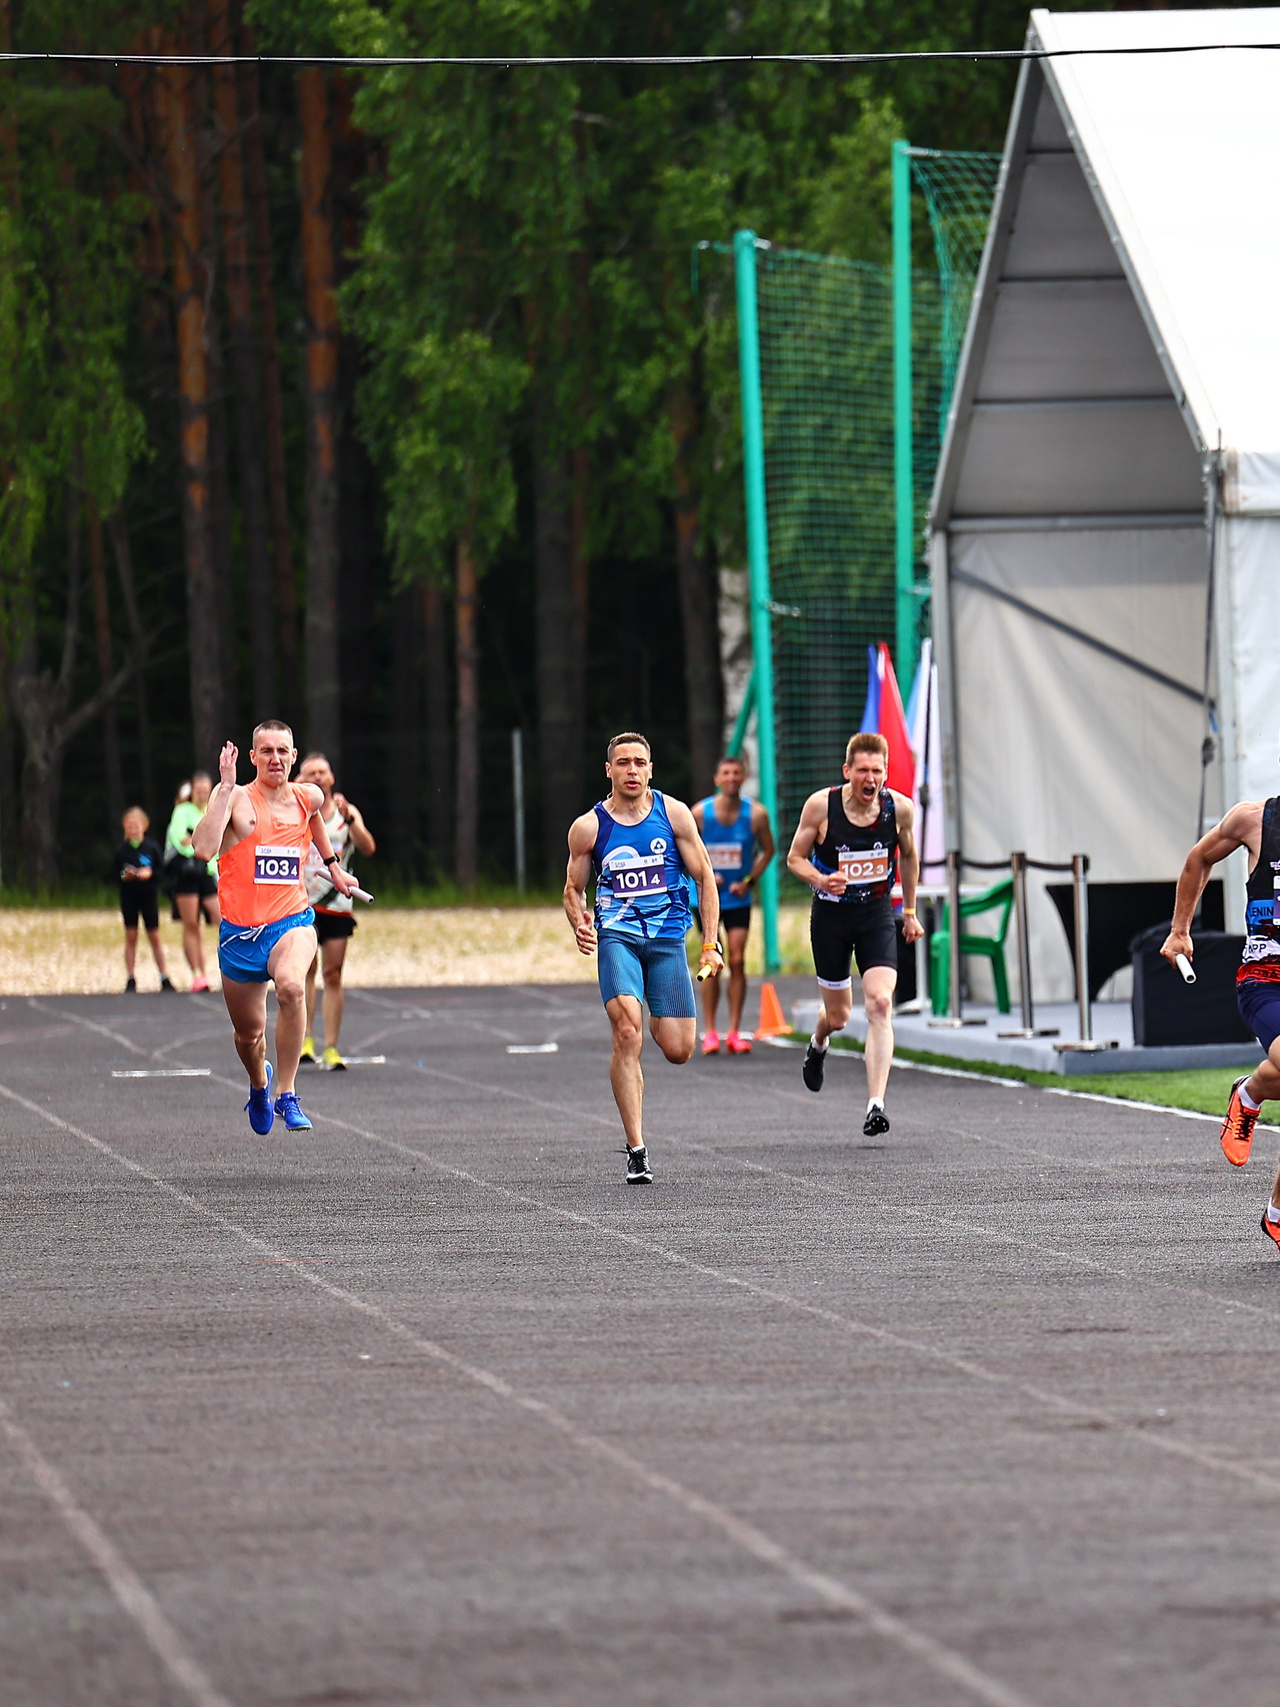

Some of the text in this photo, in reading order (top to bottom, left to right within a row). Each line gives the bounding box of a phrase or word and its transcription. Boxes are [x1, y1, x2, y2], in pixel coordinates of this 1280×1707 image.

[257, 859, 289, 876] 103
[291, 865, 297, 876] 4
[842, 862, 884, 876] 102 3
[616, 871, 660, 889] 101 4
